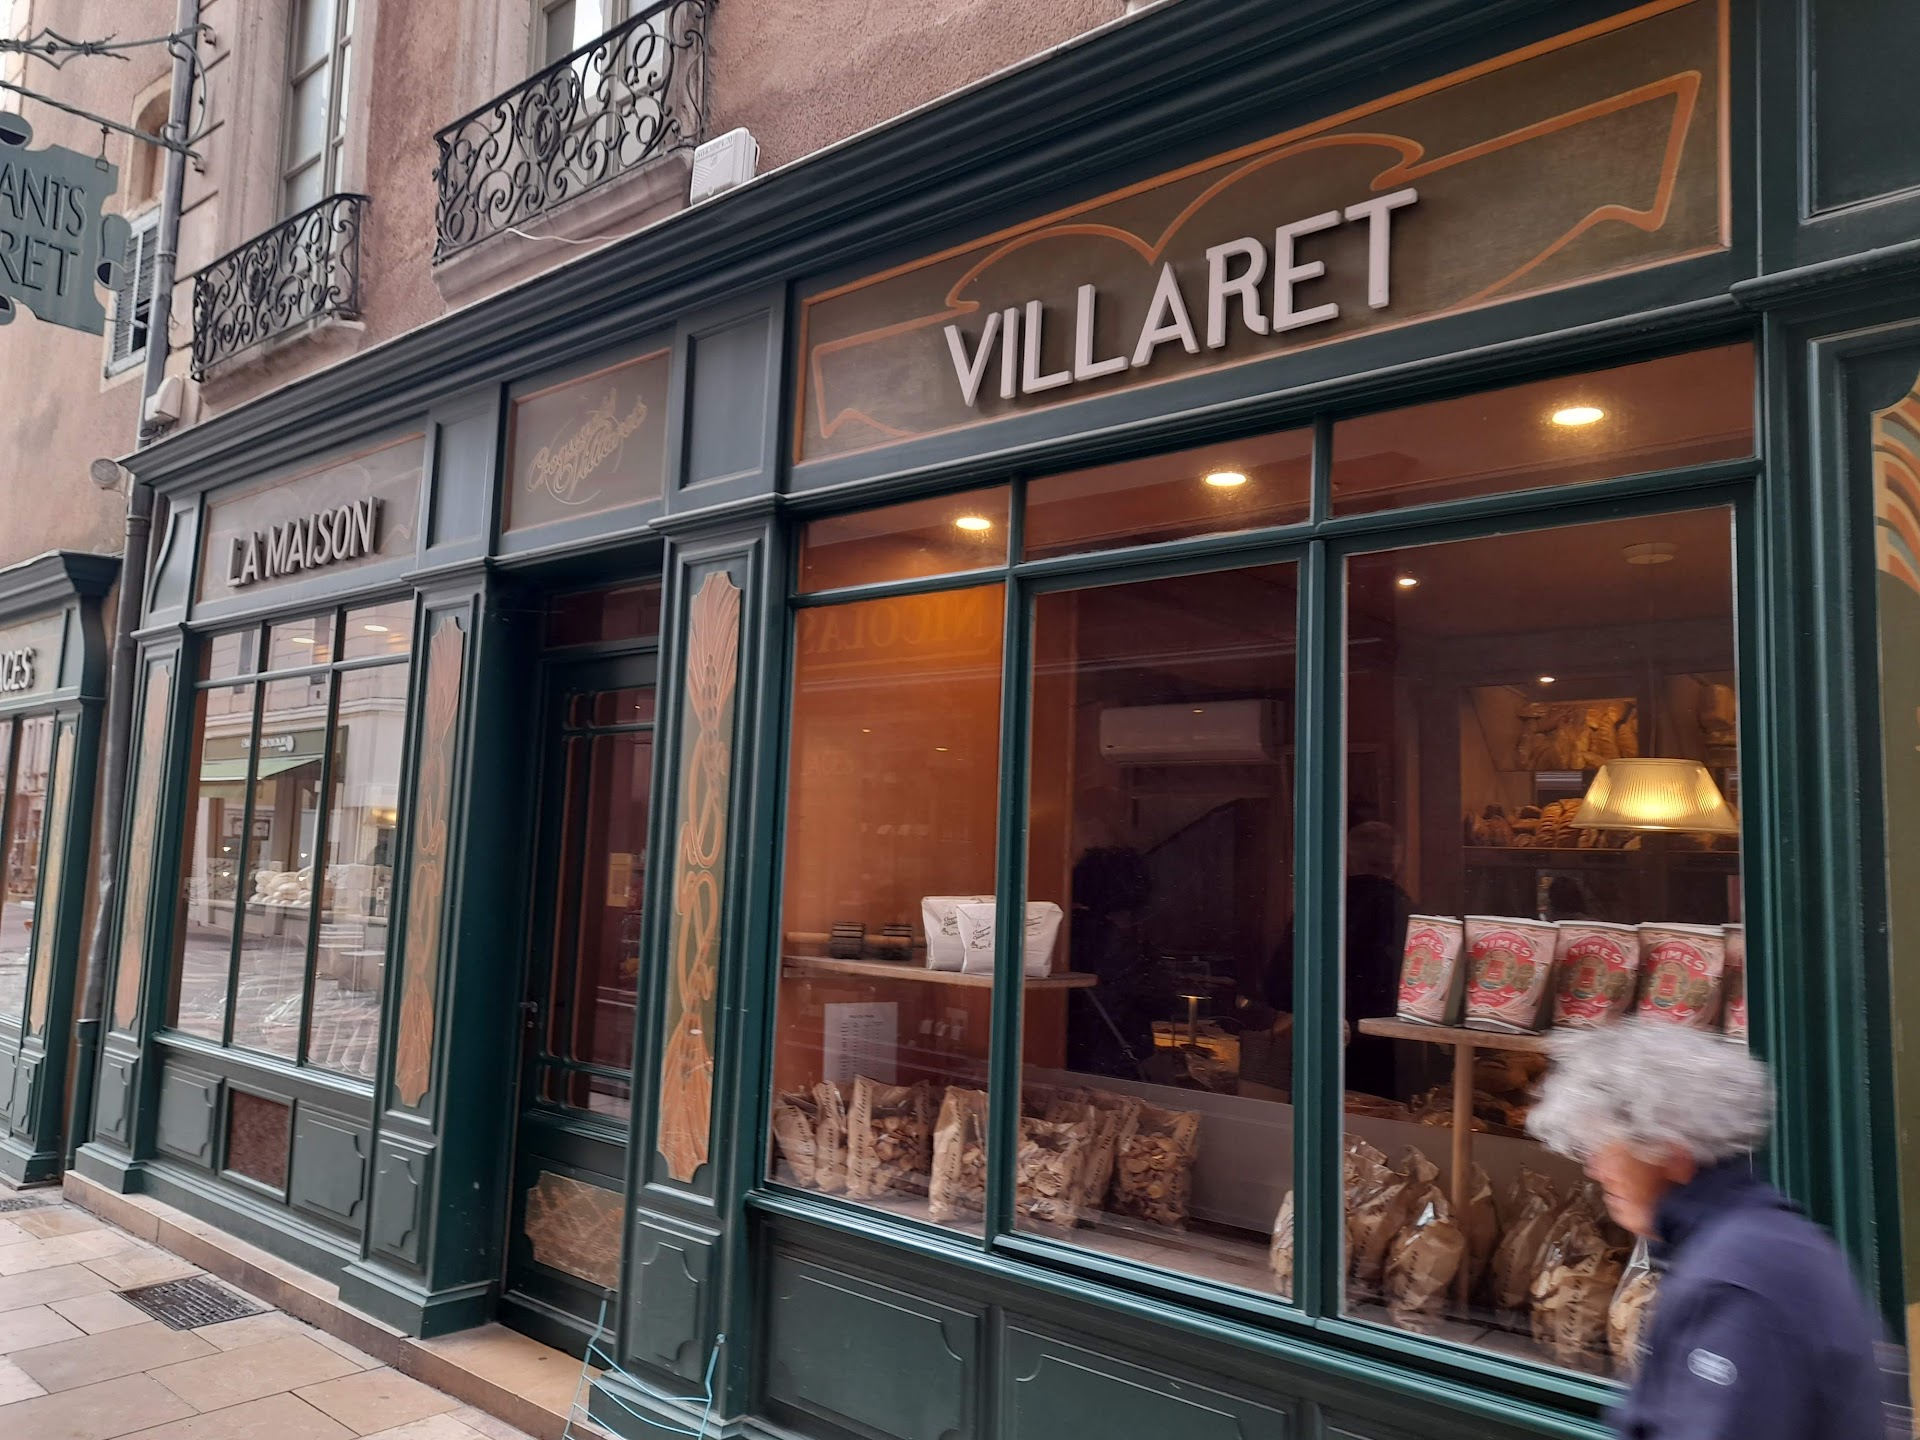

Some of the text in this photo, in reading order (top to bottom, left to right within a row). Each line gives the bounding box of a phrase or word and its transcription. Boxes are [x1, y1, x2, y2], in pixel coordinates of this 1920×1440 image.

[0, 162, 87, 237] ANTS
[944, 187, 1418, 407] VILLARET
[226, 496, 379, 587] LA MAISON
[0, 647, 33, 692] CES
[1478, 939, 1532, 957] NIMES
